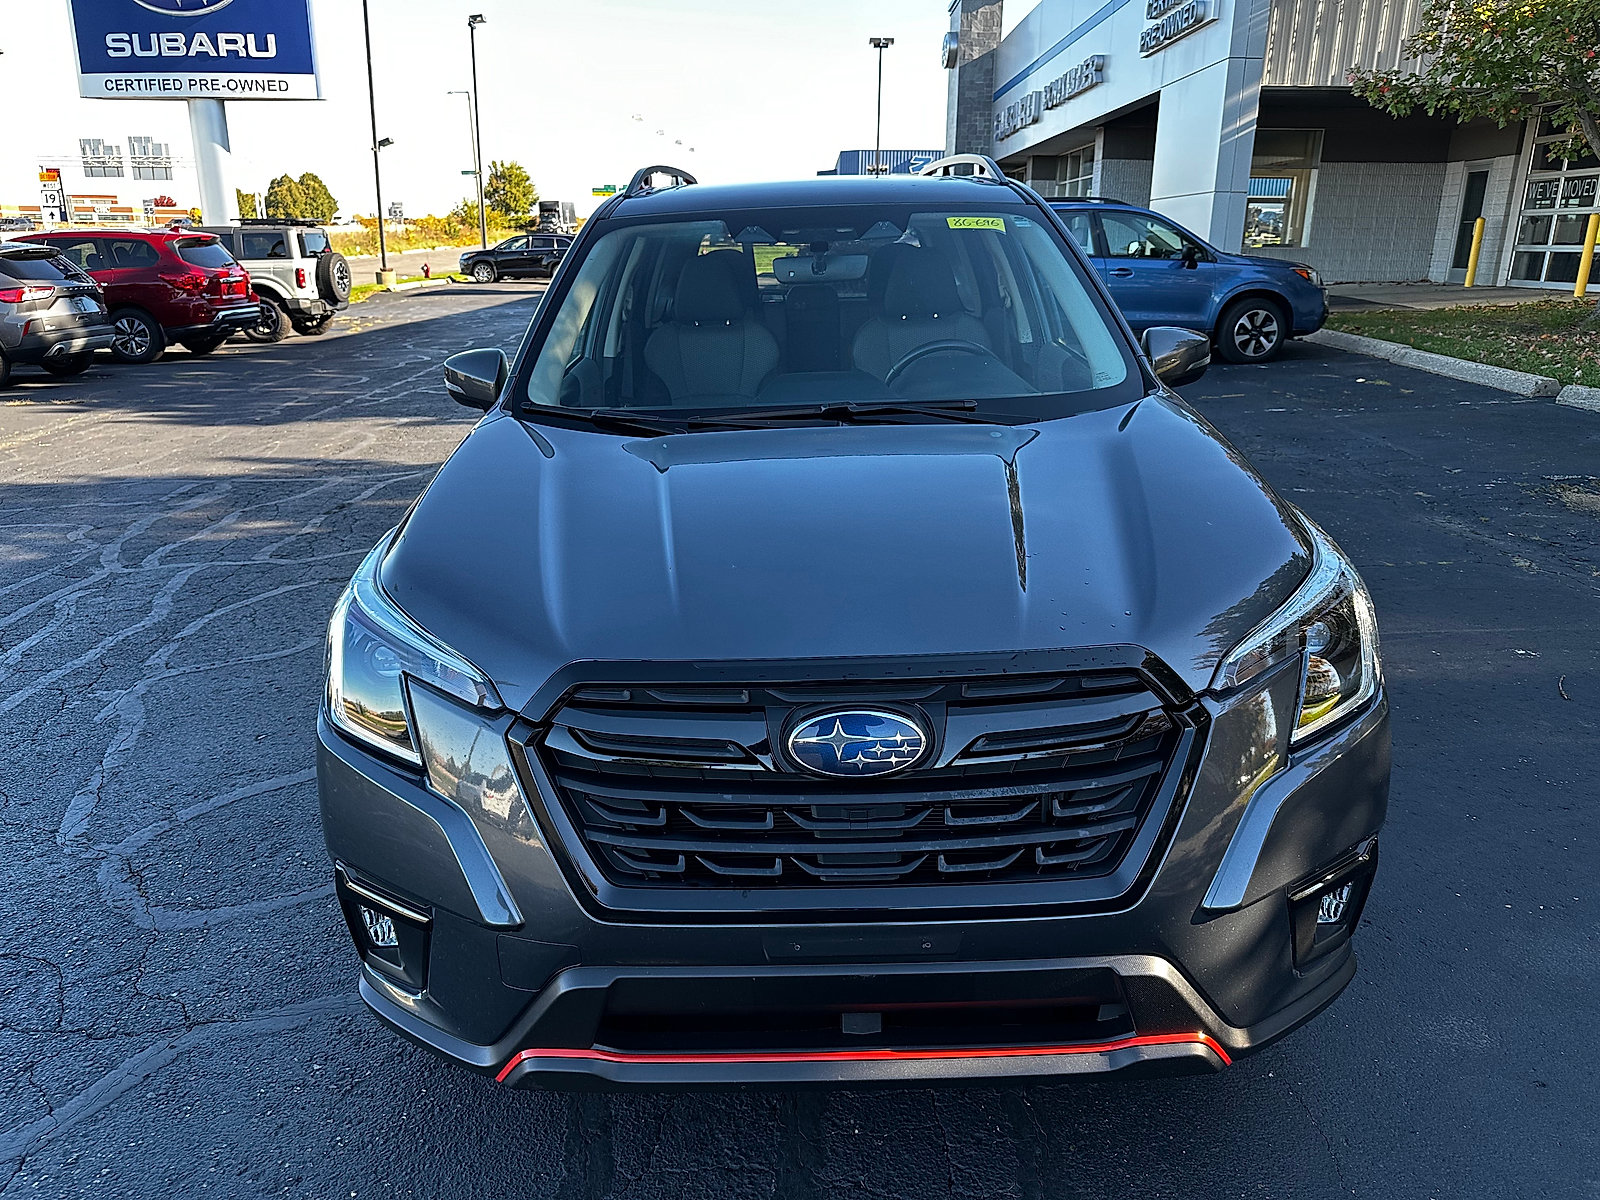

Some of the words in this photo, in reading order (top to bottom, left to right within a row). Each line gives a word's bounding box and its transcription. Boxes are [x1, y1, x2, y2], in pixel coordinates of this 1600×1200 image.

[1140, 1, 1202, 50] PRE-OWNED
[105, 33, 277, 58] SUBARU
[104, 78, 183, 92] CERTIFIED
[188, 79, 289, 92] PRE-OWNED
[1528, 181, 1560, 199] WE'VE
[1561, 179, 1598, 197] MOVED
[45, 194, 56, 204] 19
[144, 207, 155, 215] 55
